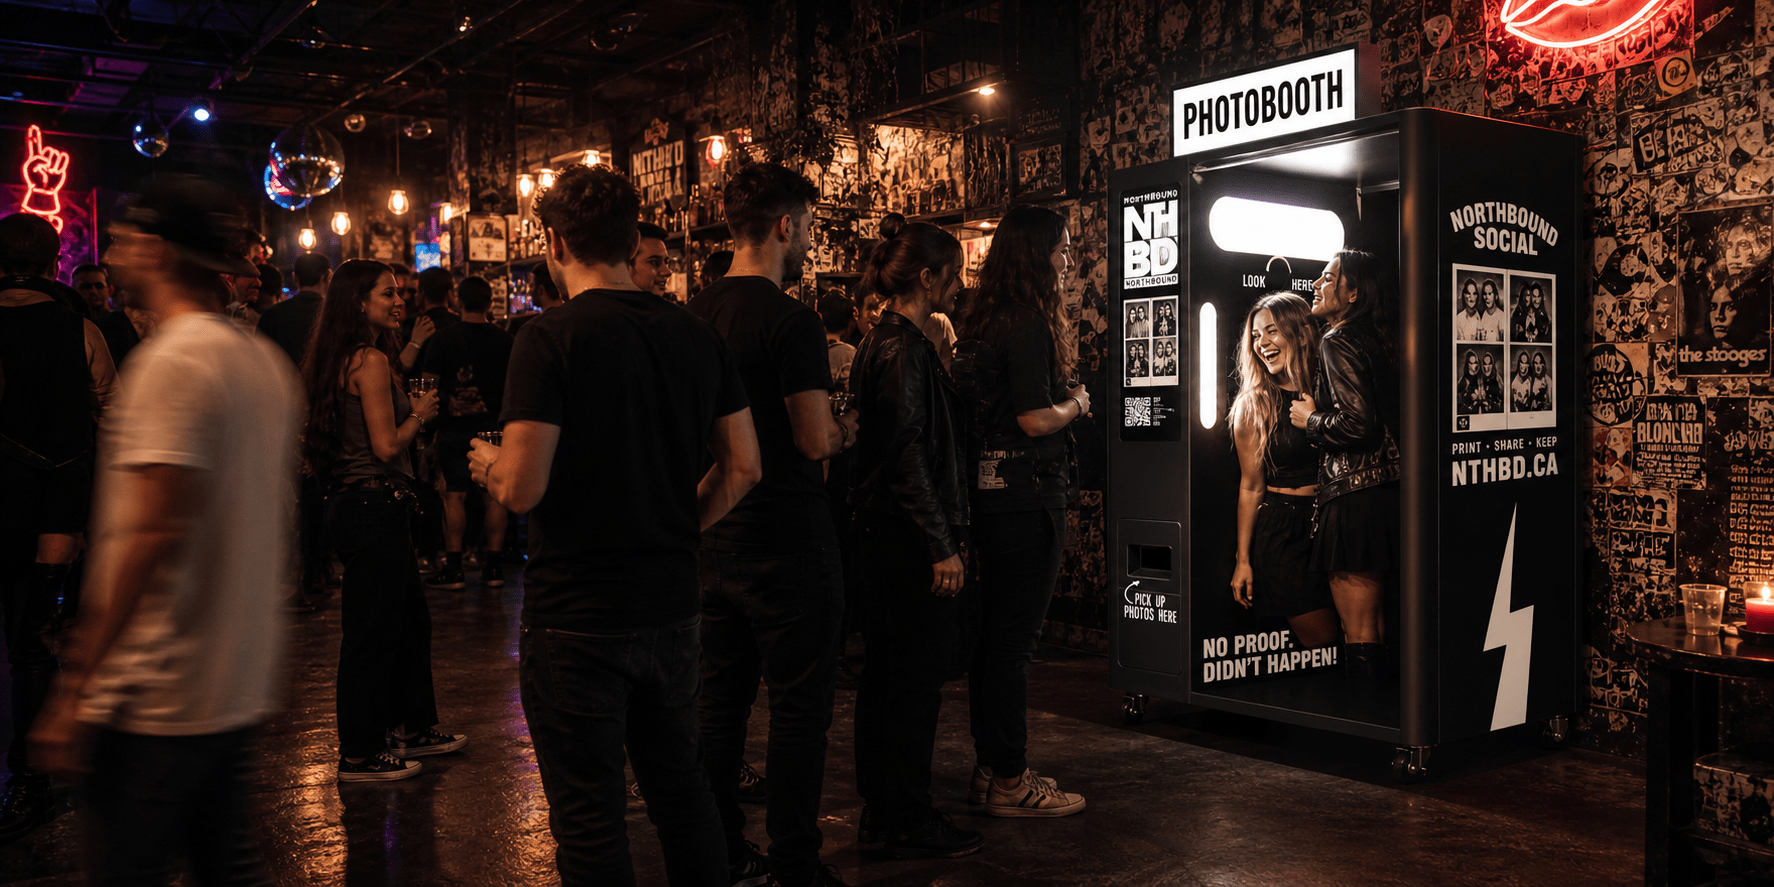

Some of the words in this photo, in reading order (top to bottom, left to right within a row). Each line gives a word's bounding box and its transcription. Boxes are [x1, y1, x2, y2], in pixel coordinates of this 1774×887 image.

[1184, 69, 1343, 140] PHOTOBOOTH
[1449, 201, 1559, 247] NORTHBOUND
[1473, 226, 1539, 256] SOCIAL
[1125, 275, 1178, 287] NORTHBOUND
[1242, 274, 1266, 288] LOOK
[1291, 278, 1313, 292] HERE
[1678, 345, 1703, 363] the
[1705, 346, 1768, 368] stooges
[1452, 441, 1482, 455] PRINT
[1494, 438, 1525, 452] SHARE
[1536, 435, 1558, 448] KEEP
[1452, 452, 1559, 487] NTHBD.CA
[1134, 592, 1152, 607] PICK
[1155, 594, 1166, 608] UP
[1124, 604, 1155, 621] PHOTOS
[1158, 608, 1178, 624] HERE
[1203, 636, 1229, 659] NO
[1234, 629, 1294, 655] PROOF.
[1203, 655, 1262, 683] DIDN'T
[1267, 646, 1338, 674] HAPPEN!
